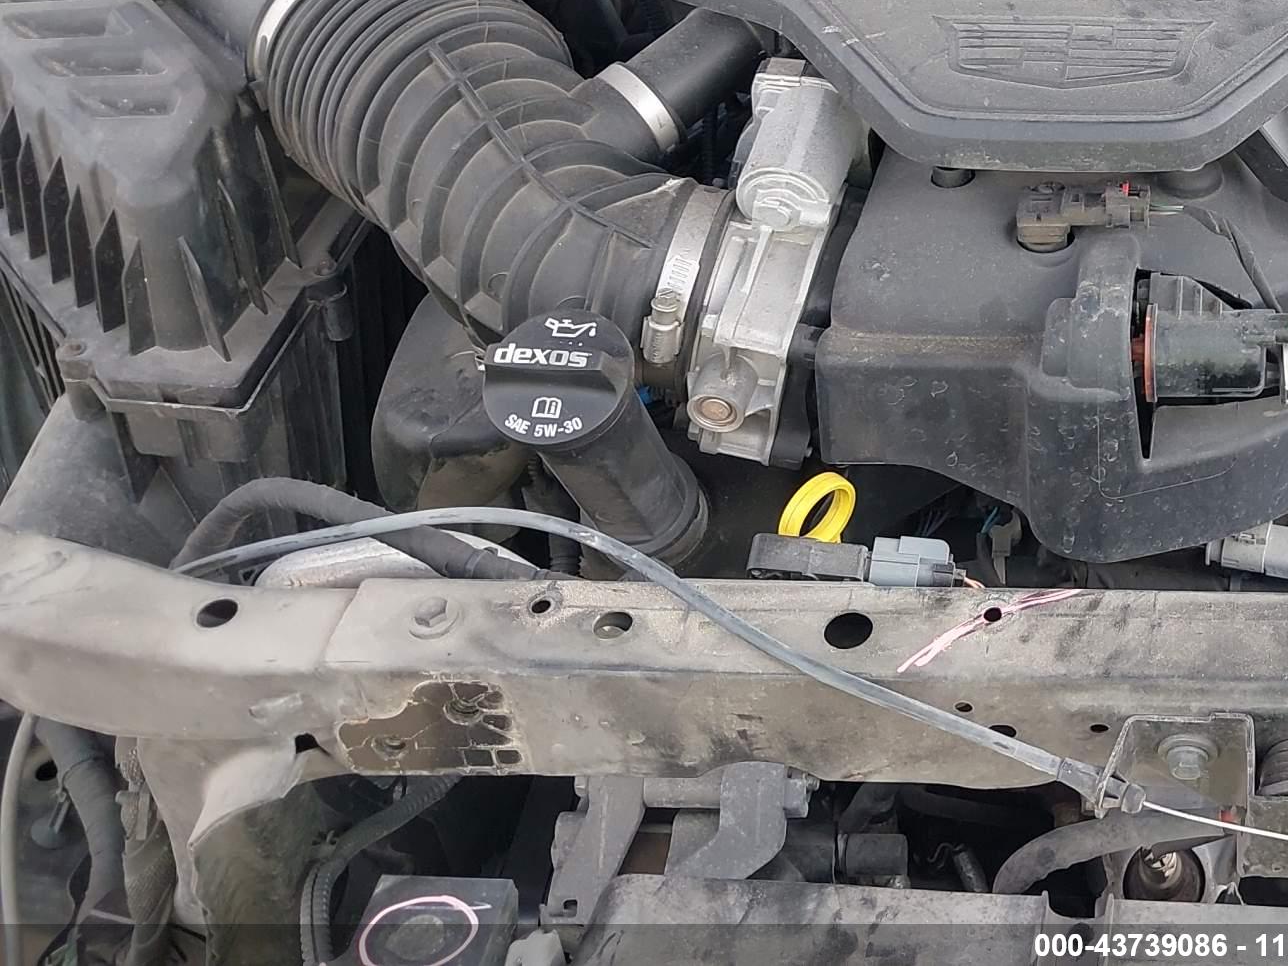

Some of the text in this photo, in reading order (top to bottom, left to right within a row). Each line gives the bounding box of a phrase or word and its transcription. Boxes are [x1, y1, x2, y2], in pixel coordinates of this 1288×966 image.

[493, 342, 592, 367] dexos
[504, 414, 582, 437] SAE 5W-30
